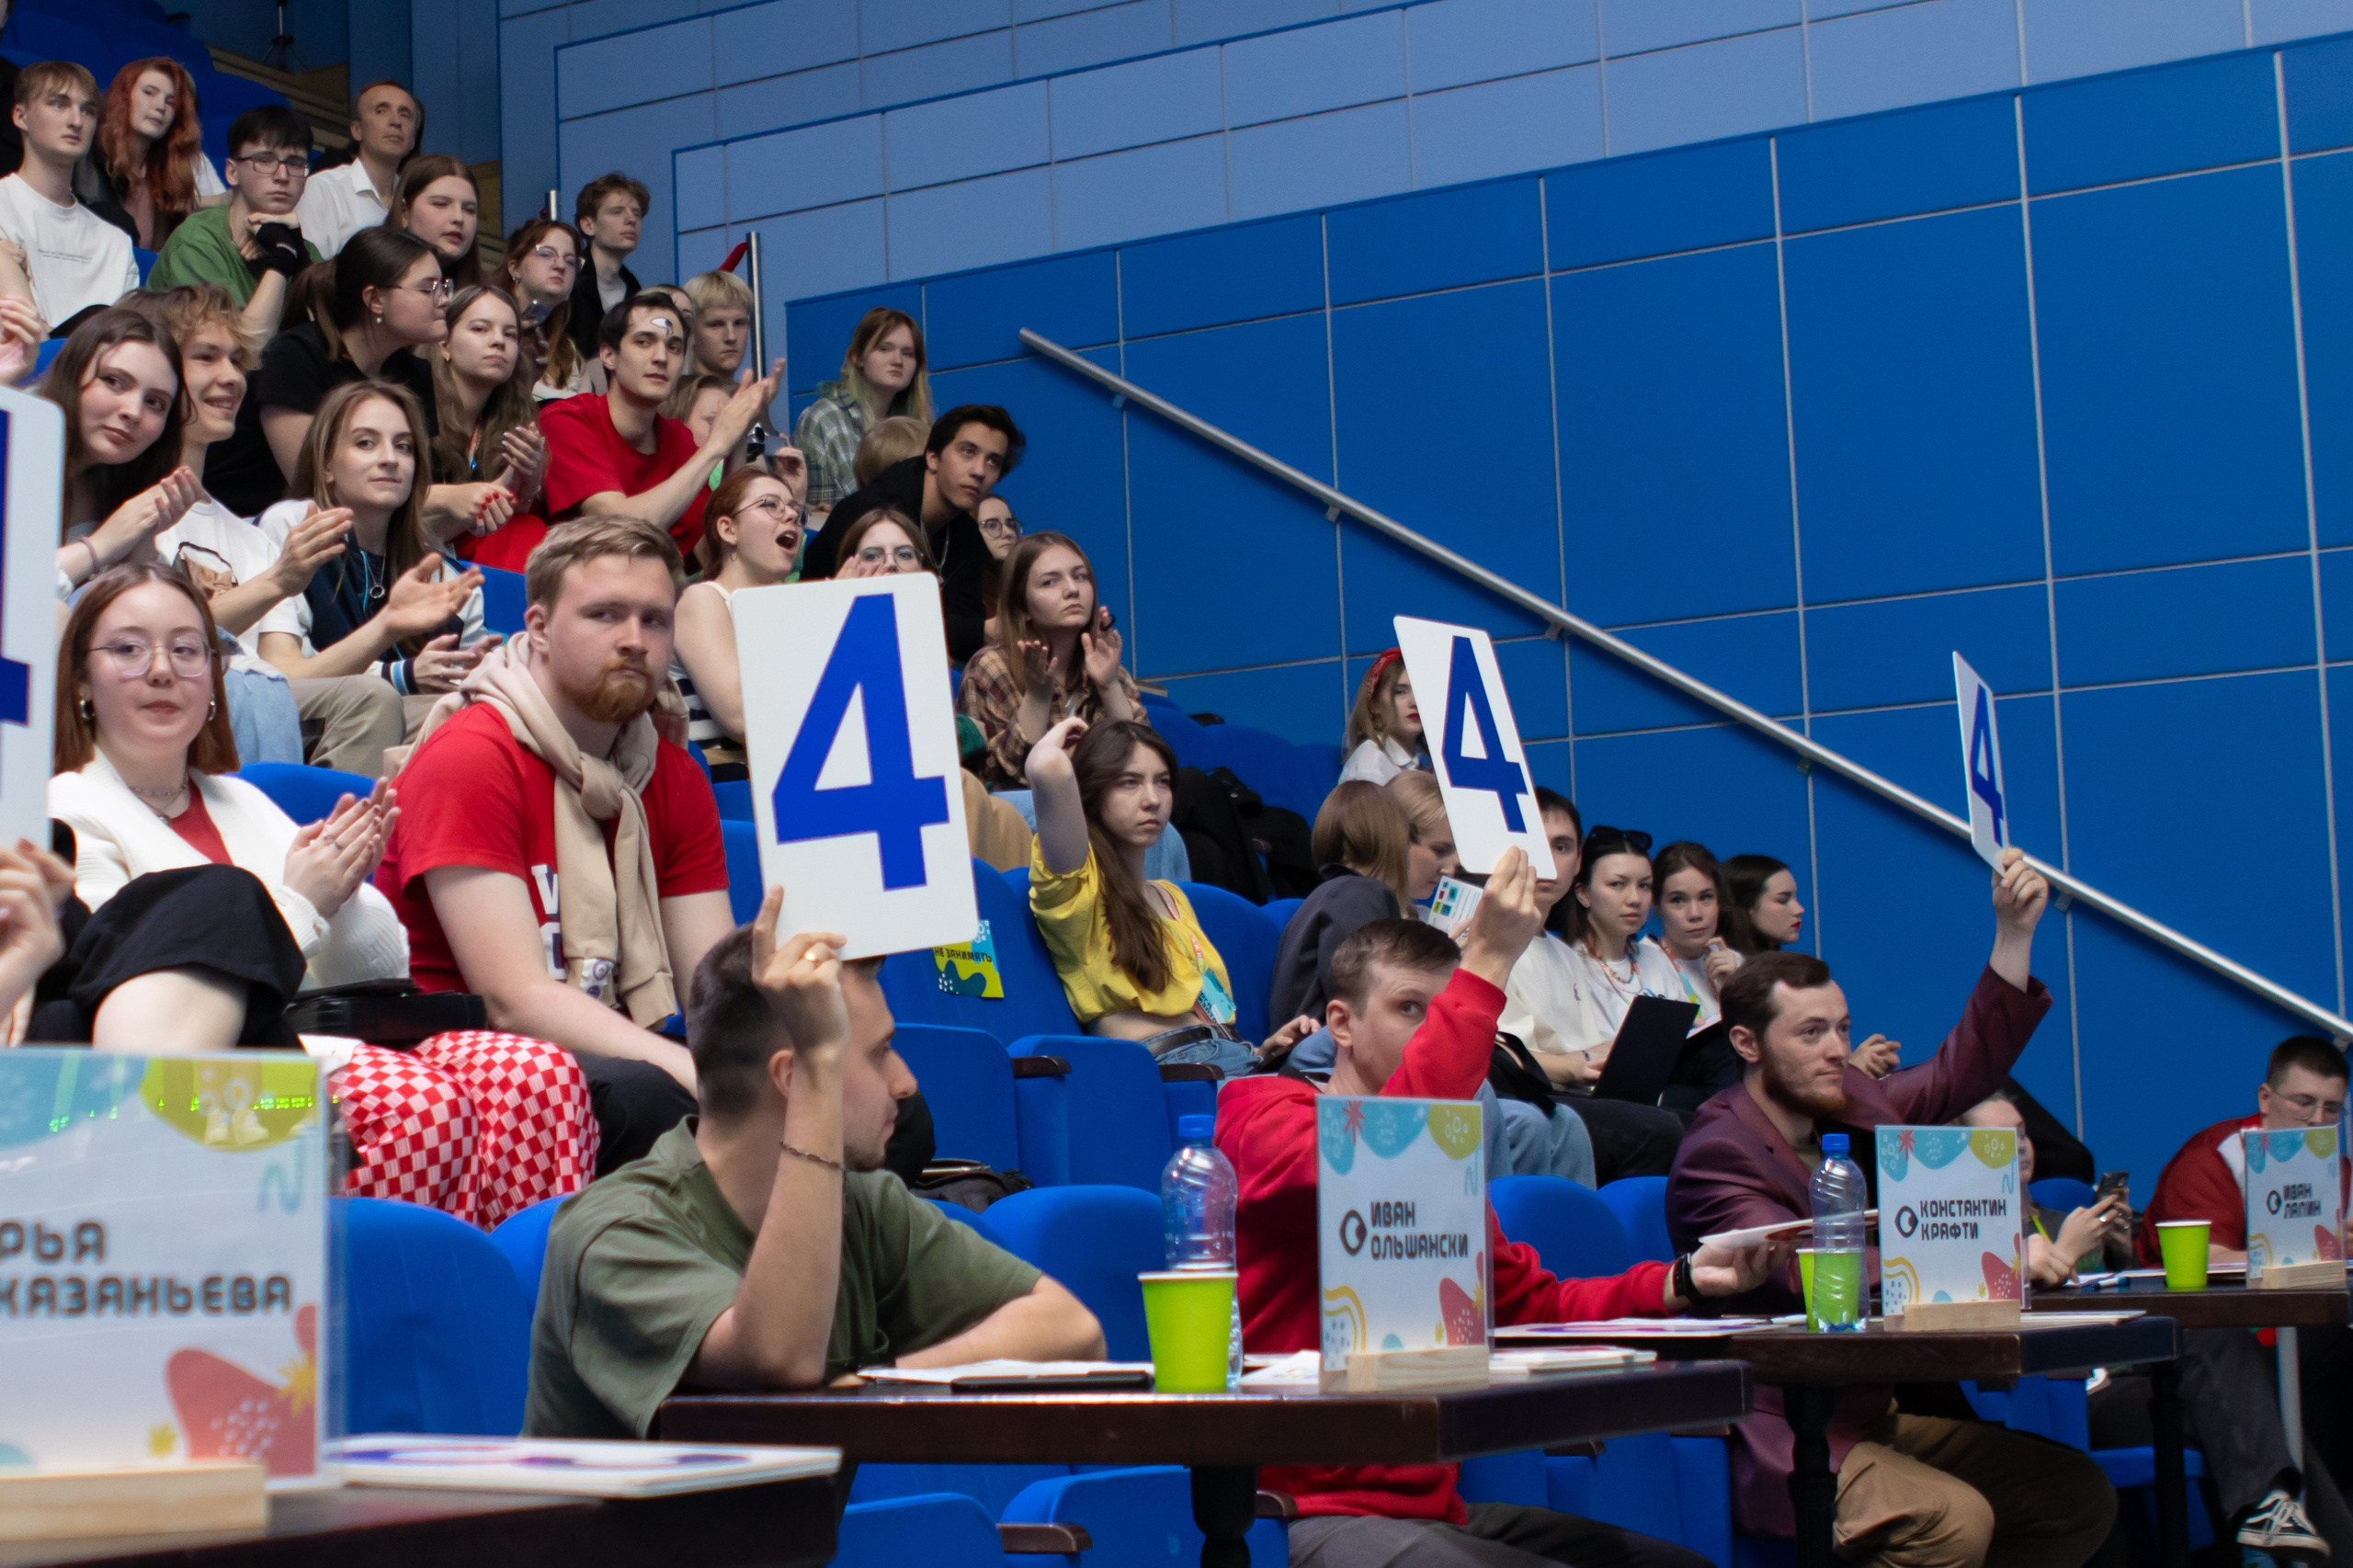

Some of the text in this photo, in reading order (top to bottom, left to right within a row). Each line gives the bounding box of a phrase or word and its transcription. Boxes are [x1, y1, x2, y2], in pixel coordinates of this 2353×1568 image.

[771, 593, 949, 892] 4
[1441, 635, 1529, 834] 4
[1970, 683, 2005, 849] 4
[934, 946, 993, 964] НЕ ЗАНИМАТЬ
[1370, 1200, 1416, 1228] ИВАН
[1920, 1199, 2007, 1219] КОНСТАНТИН
[1921, 1221, 1979, 1242] КРАФТИ
[1370, 1233, 1469, 1261] ОЛЬШАНСКИ
